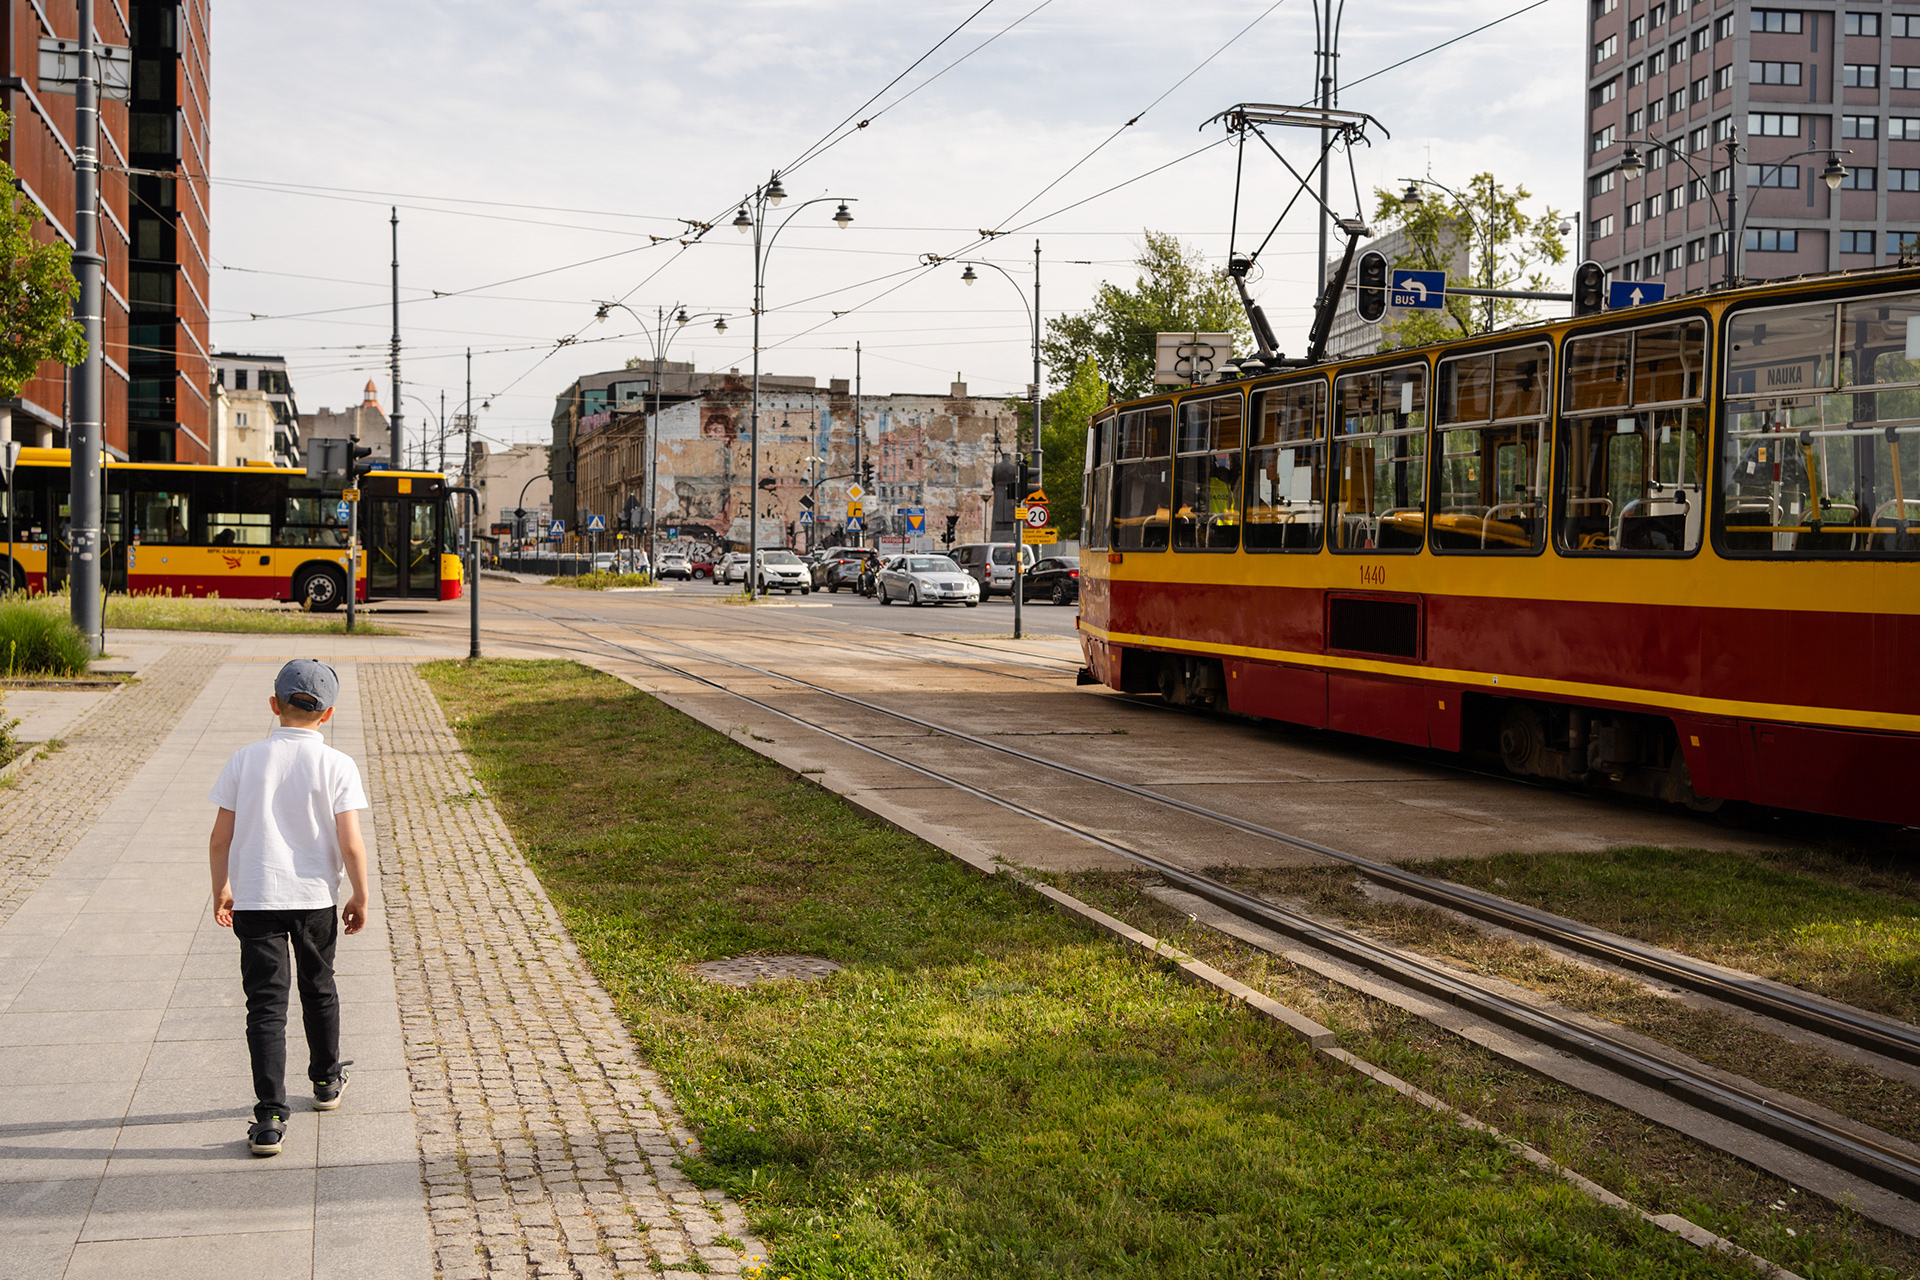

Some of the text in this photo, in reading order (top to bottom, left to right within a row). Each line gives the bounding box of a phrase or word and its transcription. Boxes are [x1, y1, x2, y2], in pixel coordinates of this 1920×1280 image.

[1395, 295, 1415, 305] BUS
[1767, 366, 1802, 386] NAUKA
[1030, 511, 1046, 522] 20
[1360, 565, 1386, 585] 1440
